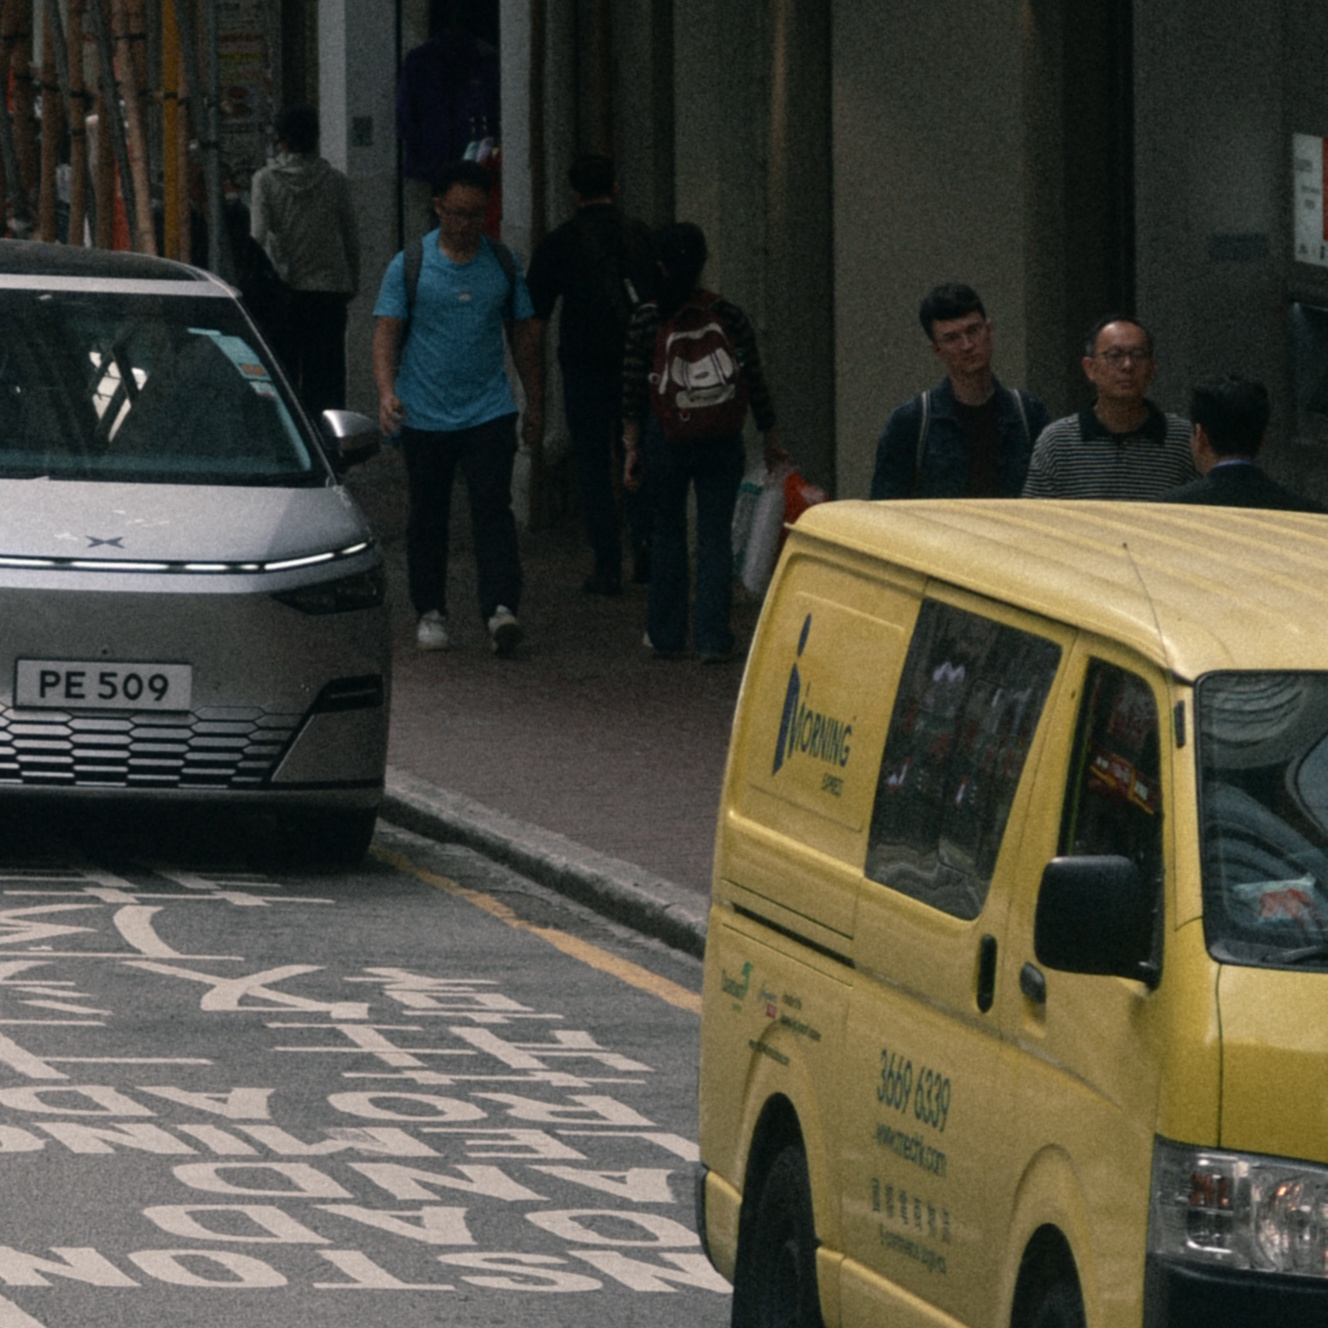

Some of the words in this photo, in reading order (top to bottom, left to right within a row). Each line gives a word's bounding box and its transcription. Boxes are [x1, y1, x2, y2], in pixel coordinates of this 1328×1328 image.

[39, 670, 86, 700] PE
[97, 672, 170, 702] 509
[876, 1048, 913, 1114] 3669
[914, 1065, 952, 1132] 6339
[143, 1203, 699, 1248] OAD
